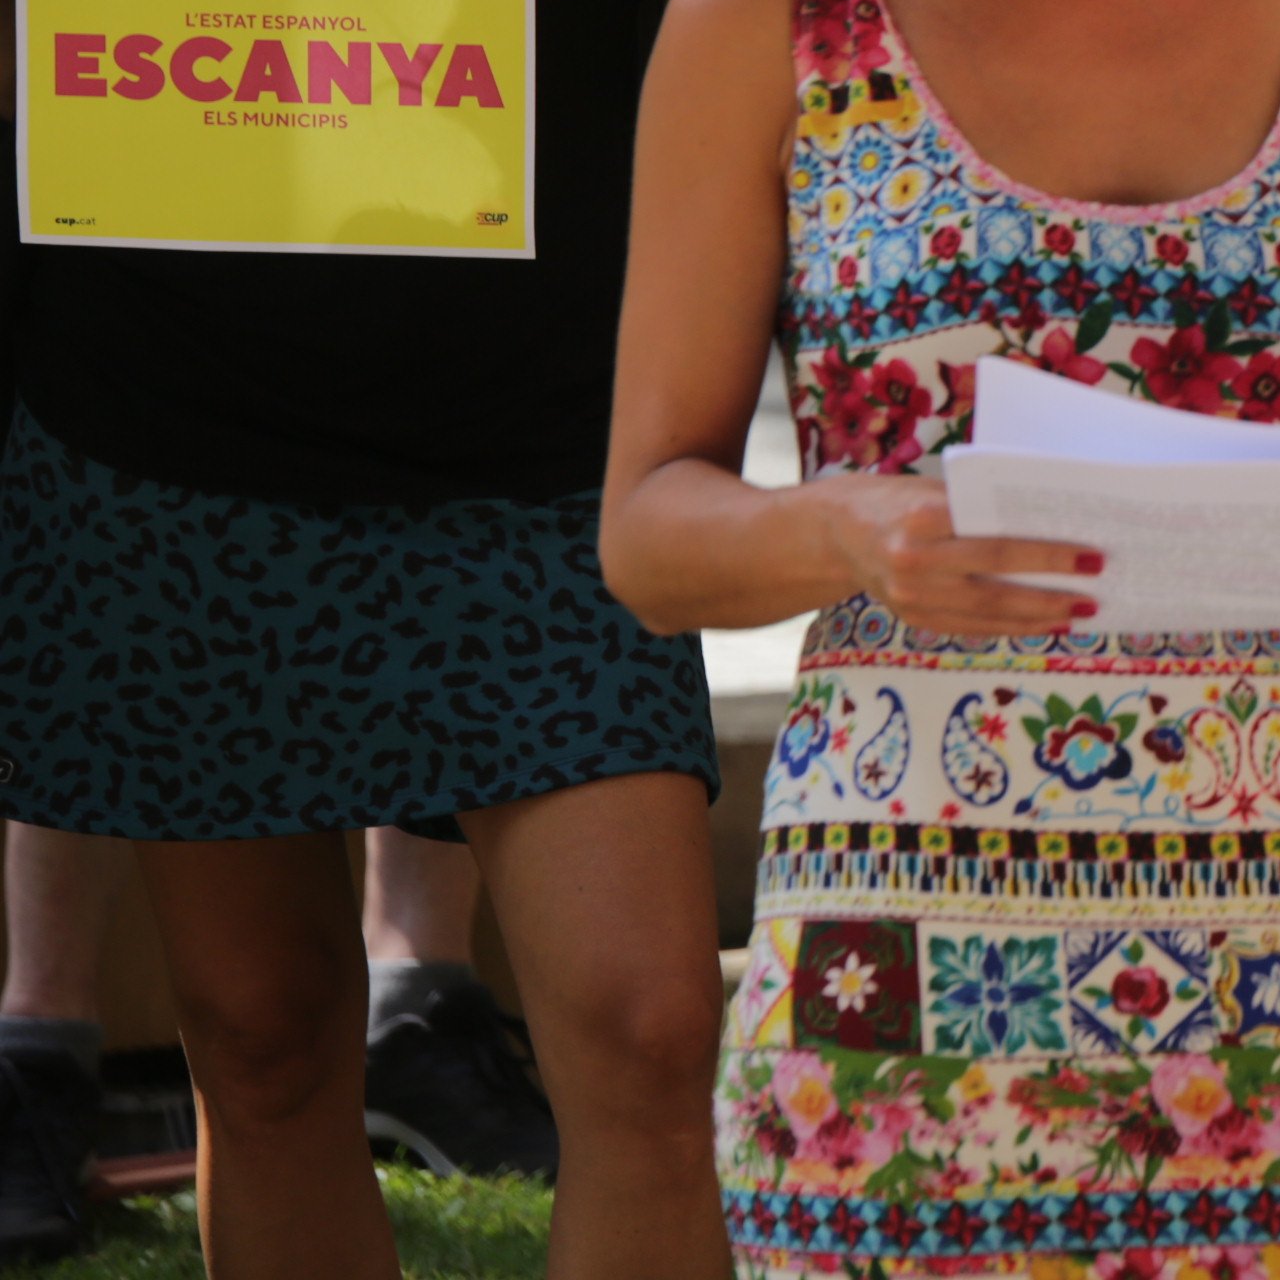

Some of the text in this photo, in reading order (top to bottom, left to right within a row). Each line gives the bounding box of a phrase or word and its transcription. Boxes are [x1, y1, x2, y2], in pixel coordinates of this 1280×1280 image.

[185, 12, 367, 32] L'ESTAT ESPANYOL
[54, 32, 505, 109] ESCANYA
[203, 111, 348, 129] ELS MUNICIPIS
[55, 217, 97, 227] cup.cat
